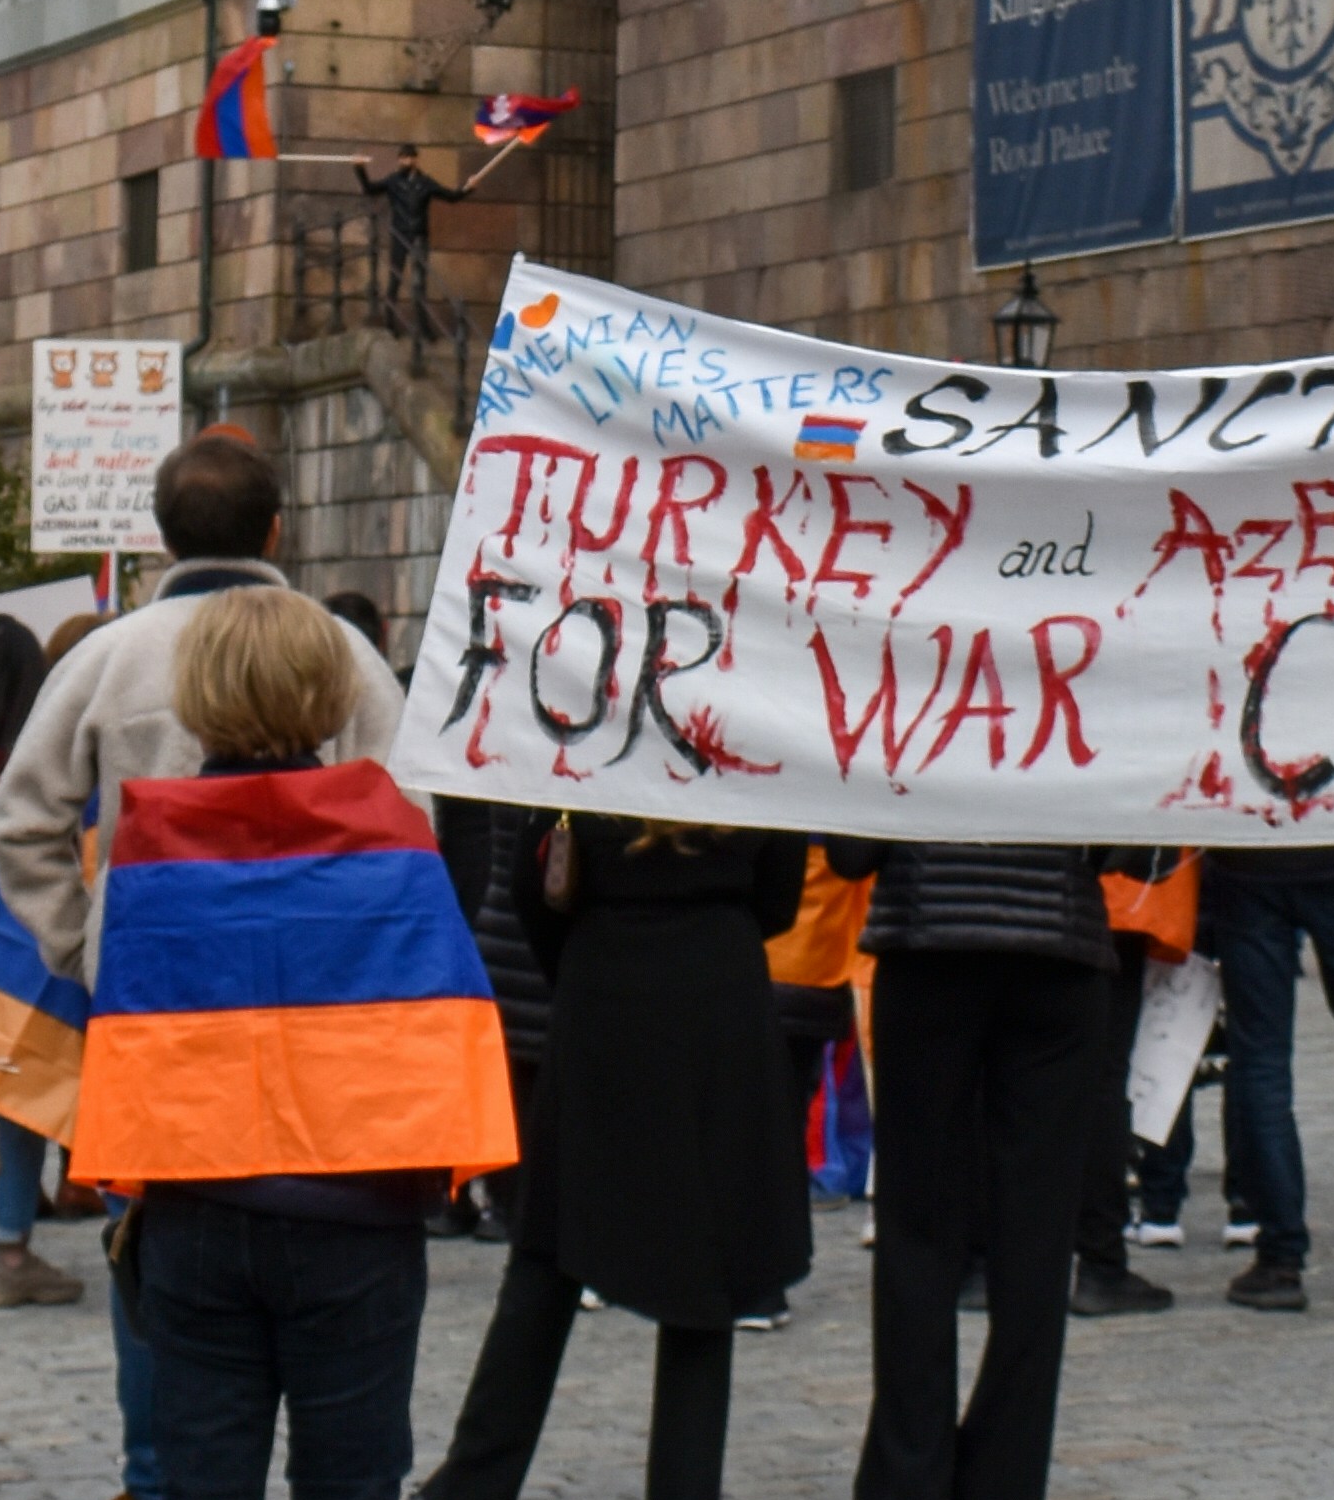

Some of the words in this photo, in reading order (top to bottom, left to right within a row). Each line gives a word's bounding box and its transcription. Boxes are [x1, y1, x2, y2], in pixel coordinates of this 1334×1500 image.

[987, 76, 1078, 117] Welcome
[1082, 70, 1103, 99] to
[1104, 55, 1139, 95] the
[988, 130, 1044, 182] Royal
[1050, 122, 1112, 166] Palace
[474, 309, 698, 428] ARMENIAN
[569, 346, 729, 427] LIVES
[651, 365, 895, 449] MATTERS
[43, 493, 77, 514] GAS
[56, 471, 89, 492] long
[469, 434, 974, 602] TURKEY
[997, 509, 1097, 581] and
[440, 580, 725, 776] FOR
[807, 614, 1102, 785] WAR
